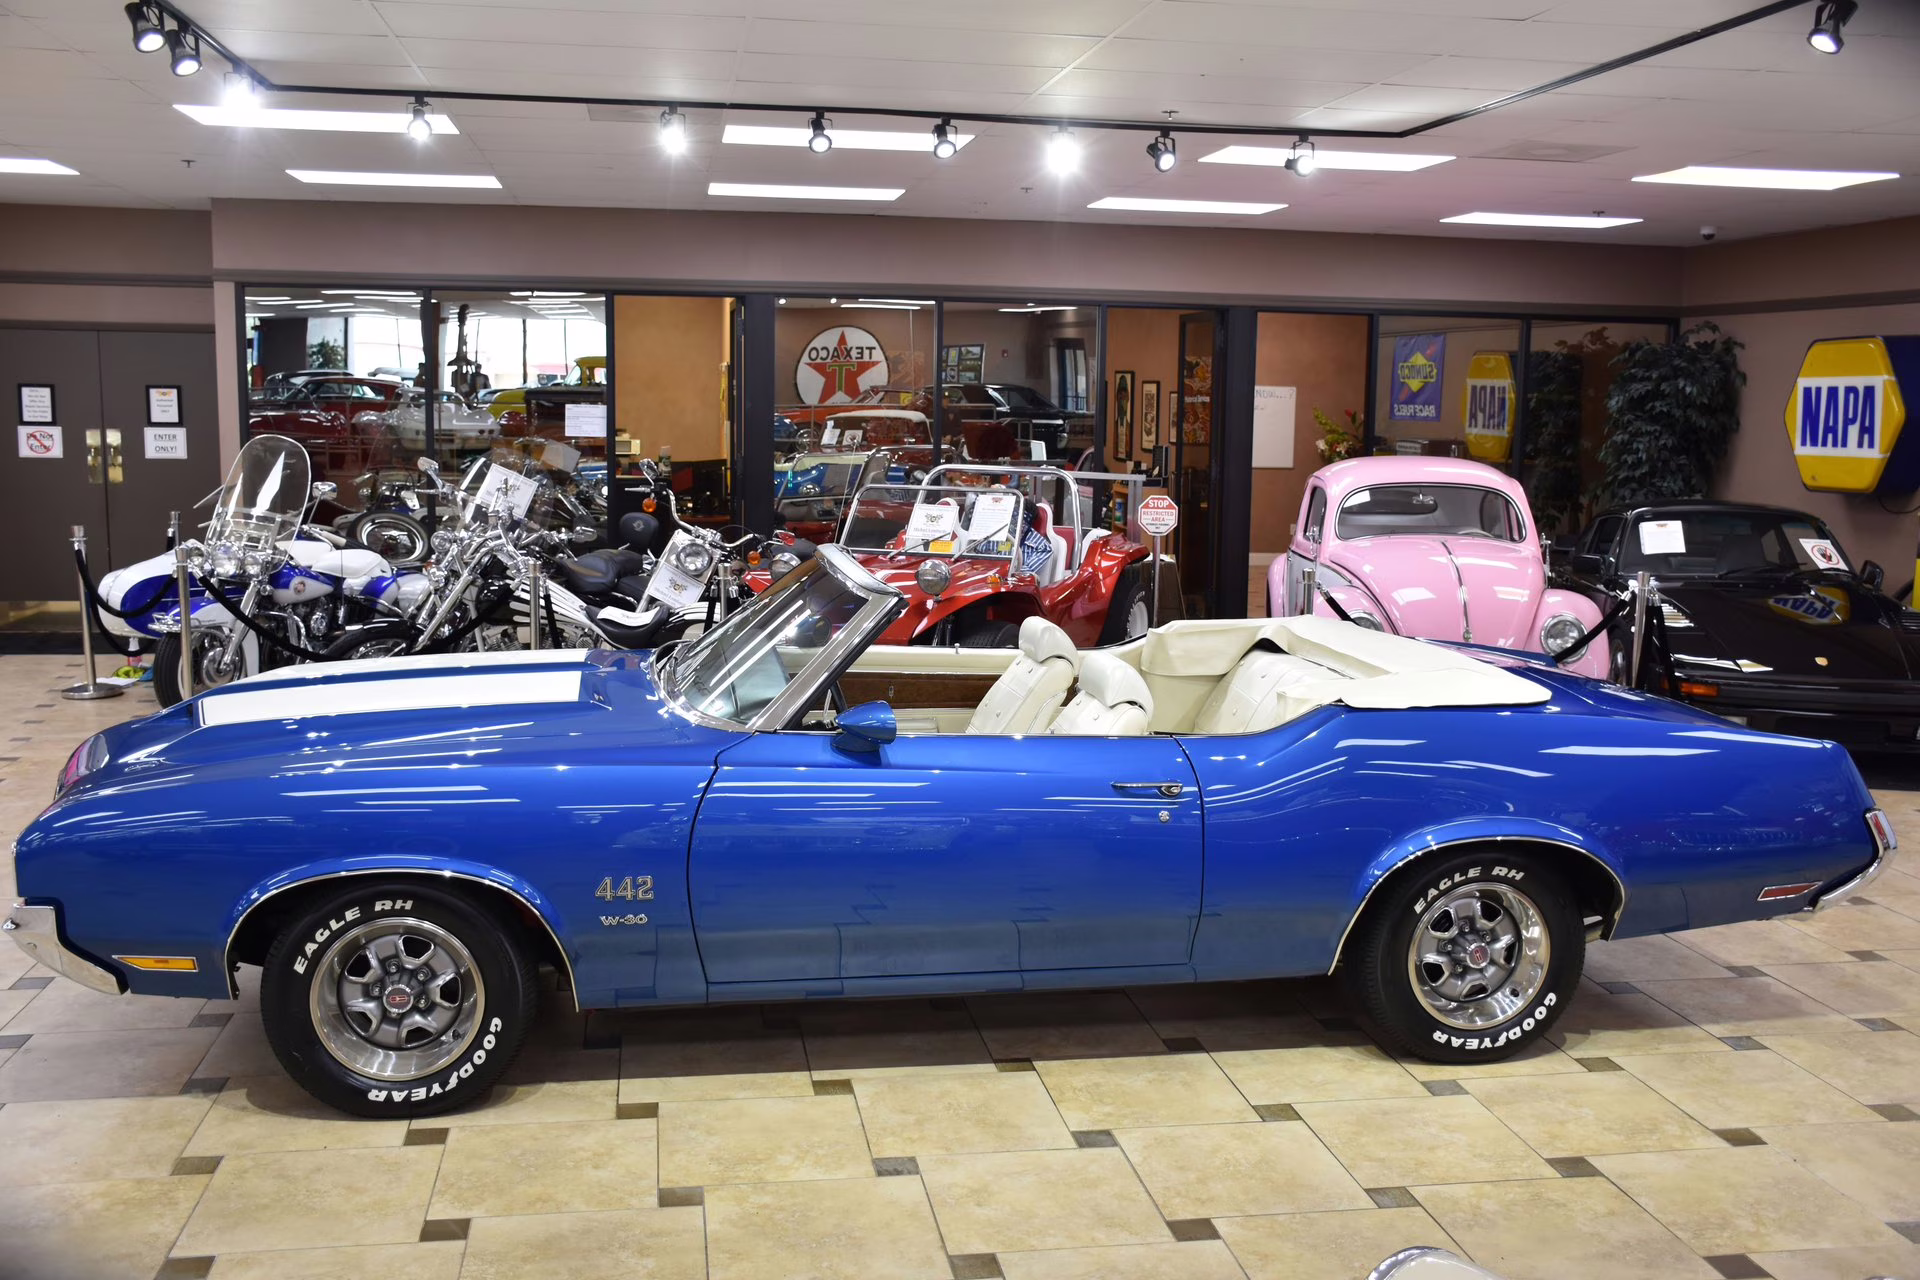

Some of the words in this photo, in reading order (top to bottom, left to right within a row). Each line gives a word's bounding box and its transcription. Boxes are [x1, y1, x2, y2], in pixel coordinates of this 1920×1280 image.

[1800, 385, 1876, 449] NAPA
[39, 432, 54, 440] Not
[153, 433, 177, 441] ENTER
[1148, 499, 1170, 508] STOP
[595, 875, 654, 901] 442
[1413, 866, 1483, 914] EAGLE
[1491, 866, 1525, 881] RH
[293, 906, 361, 975] EAGLE
[374, 899, 414, 912] RH
[600, 914, 648, 926] W-30
[1432, 992, 1557, 1050] GOODYEAR
[367, 1016, 503, 1102] GOODYEAR
